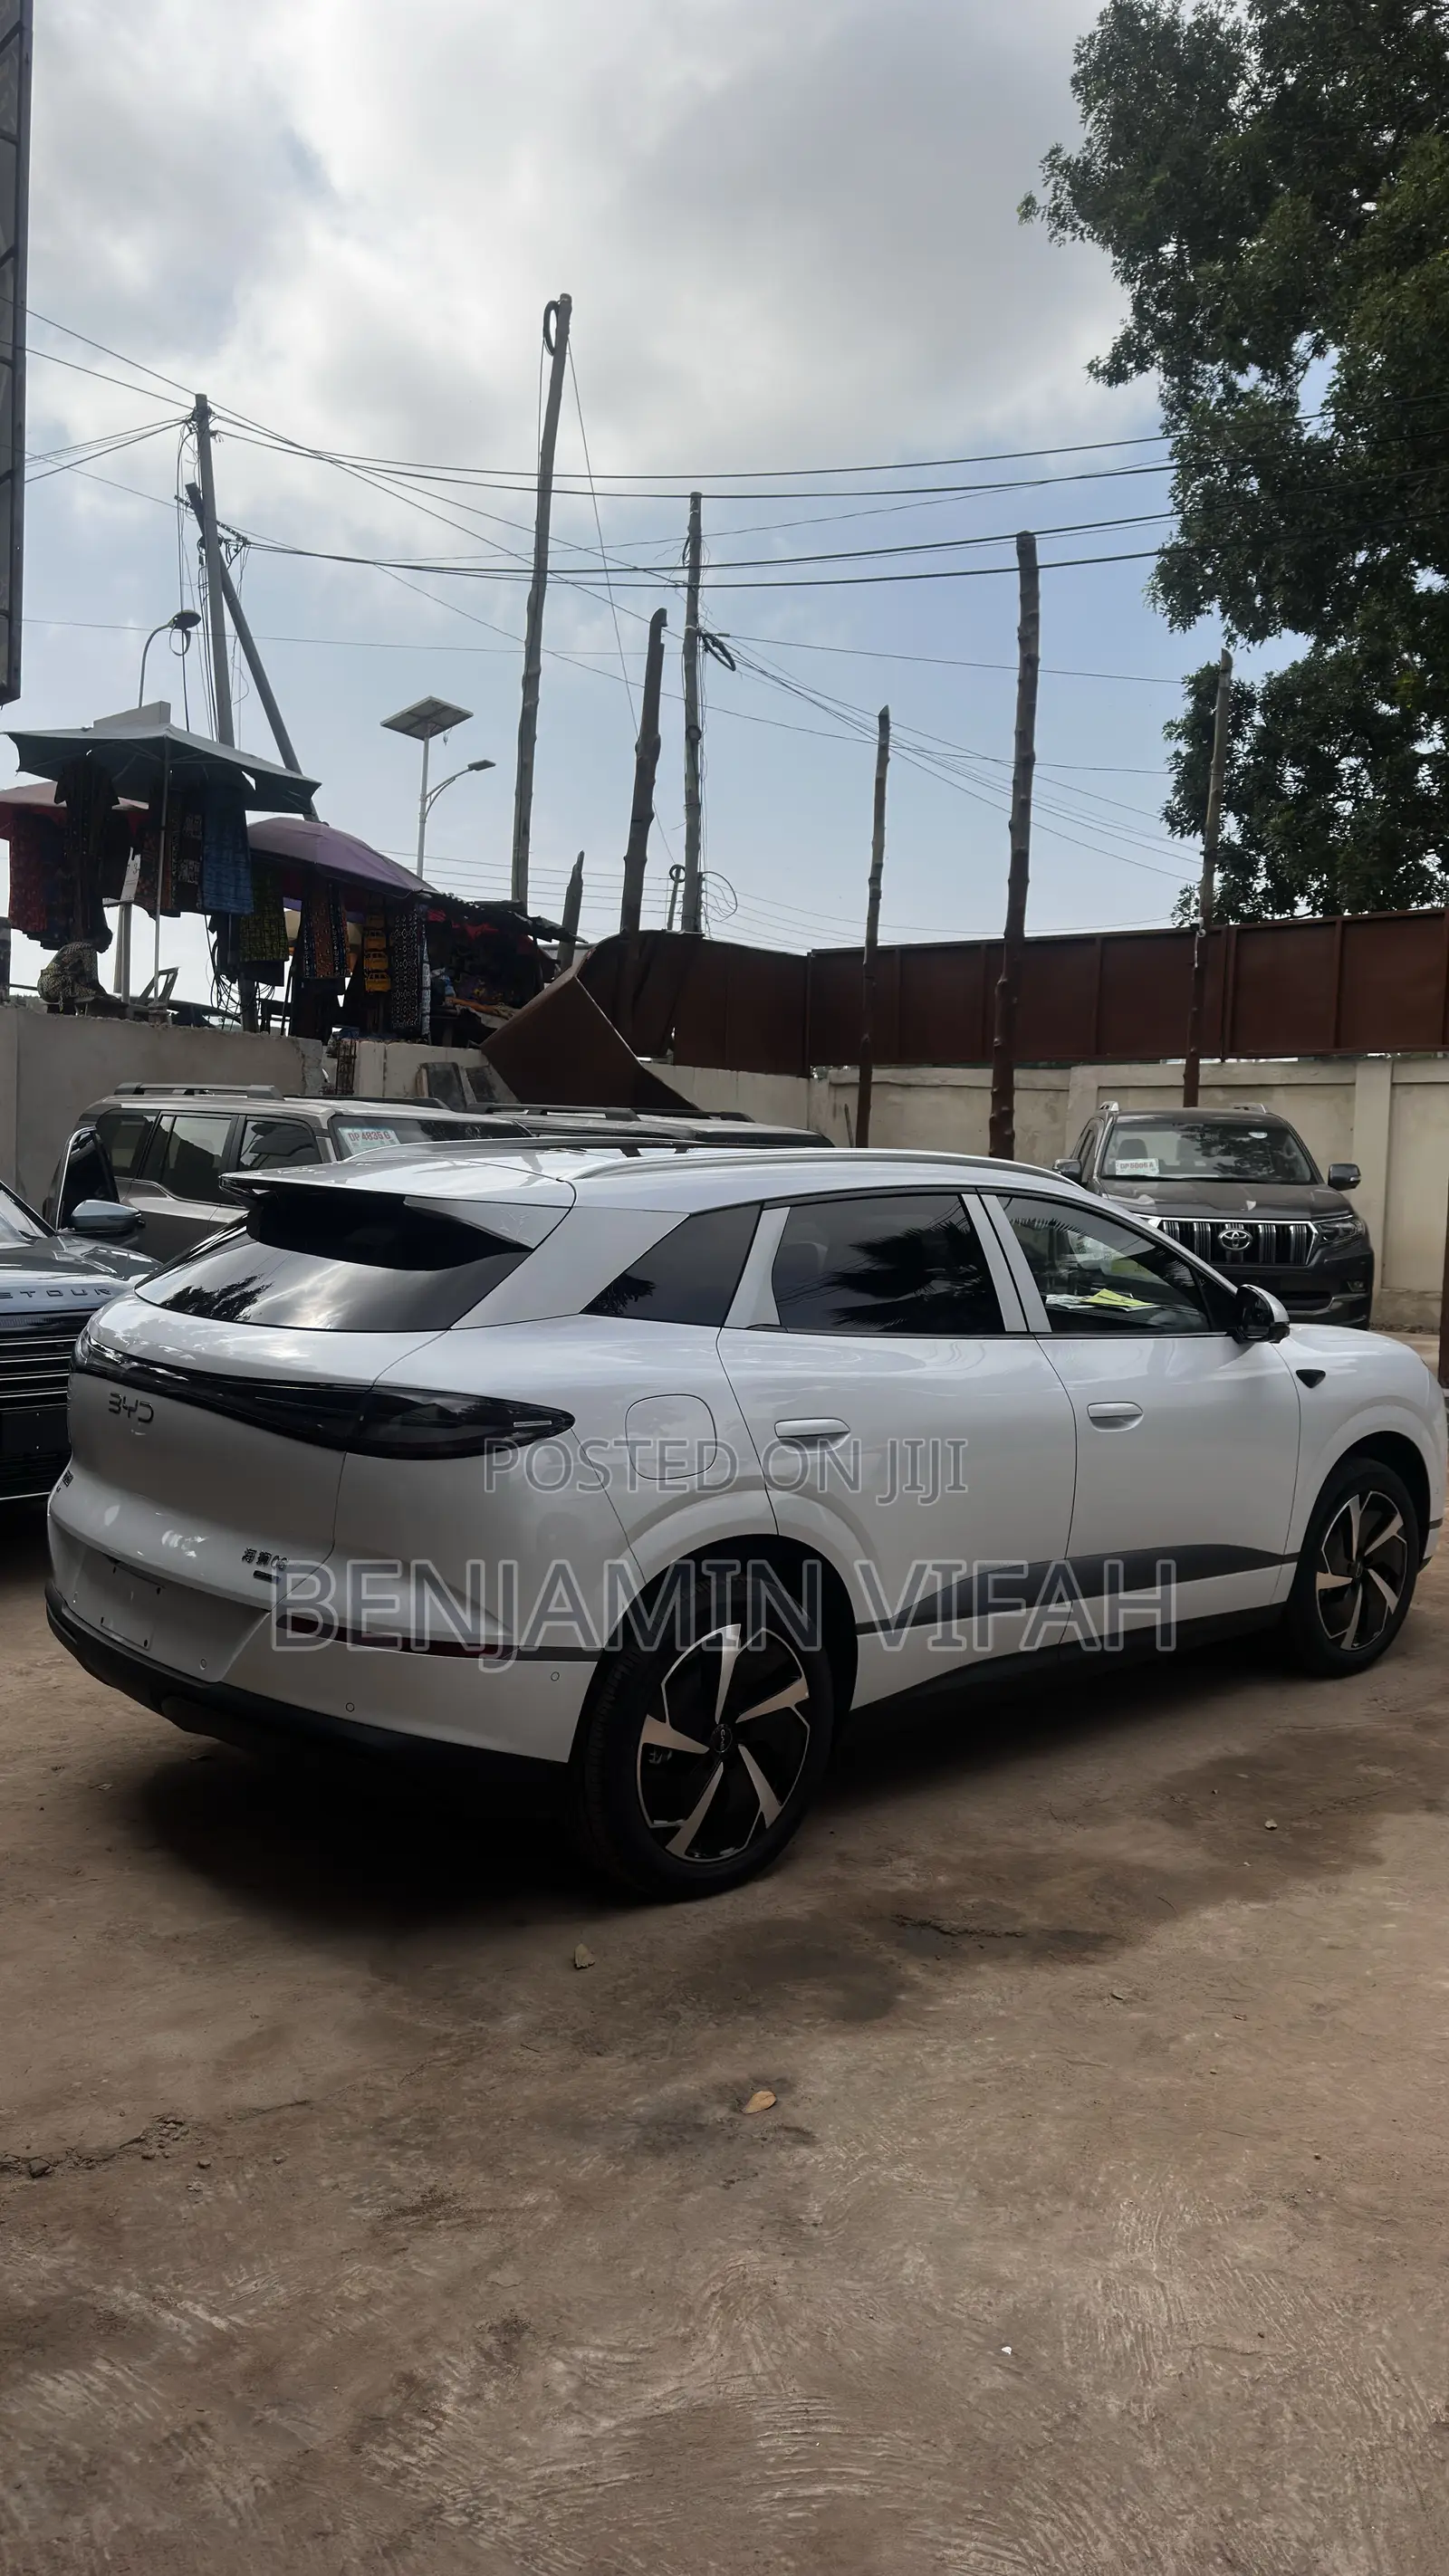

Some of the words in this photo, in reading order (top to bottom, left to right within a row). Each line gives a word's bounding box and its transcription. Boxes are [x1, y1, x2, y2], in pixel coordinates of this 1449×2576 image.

[348, 1132, 360, 1142] DP
[361, 1130, 384, 1141] 4835
[383, 1130, 391, 1140] G
[0, 1288, 111, 1299] ETOUR
[108, 1392, 154, 1423] BYD
